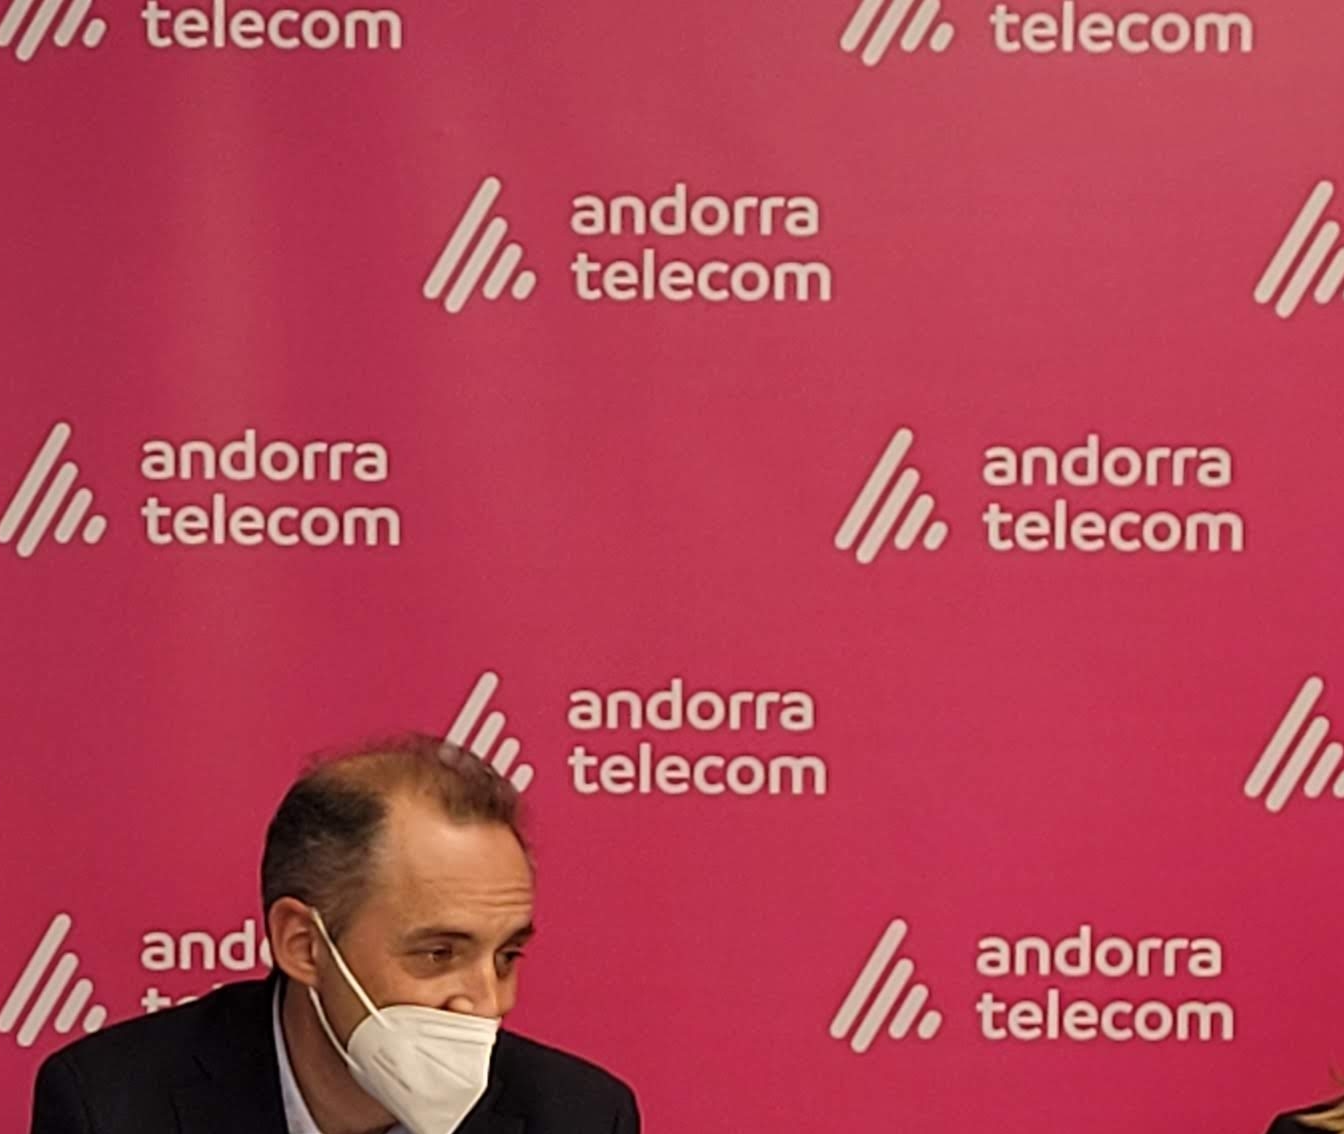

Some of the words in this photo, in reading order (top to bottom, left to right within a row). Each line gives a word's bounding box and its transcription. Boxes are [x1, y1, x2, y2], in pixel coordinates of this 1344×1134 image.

[142, 0, 401, 48] telecom
[989, 0, 1253, 53] telecom
[571, 184, 819, 236] andorra
[571, 249, 831, 302] telecom
[141, 429, 388, 482] andorra
[983, 435, 1232, 487] andorra
[141, 494, 400, 546] telecom
[982, 499, 1243, 552] telecom
[568, 679, 814, 731] andorra
[568, 743, 826, 795] telecom
[976, 925, 1222, 977] andorra
[976, 989, 1234, 1041] telecom
